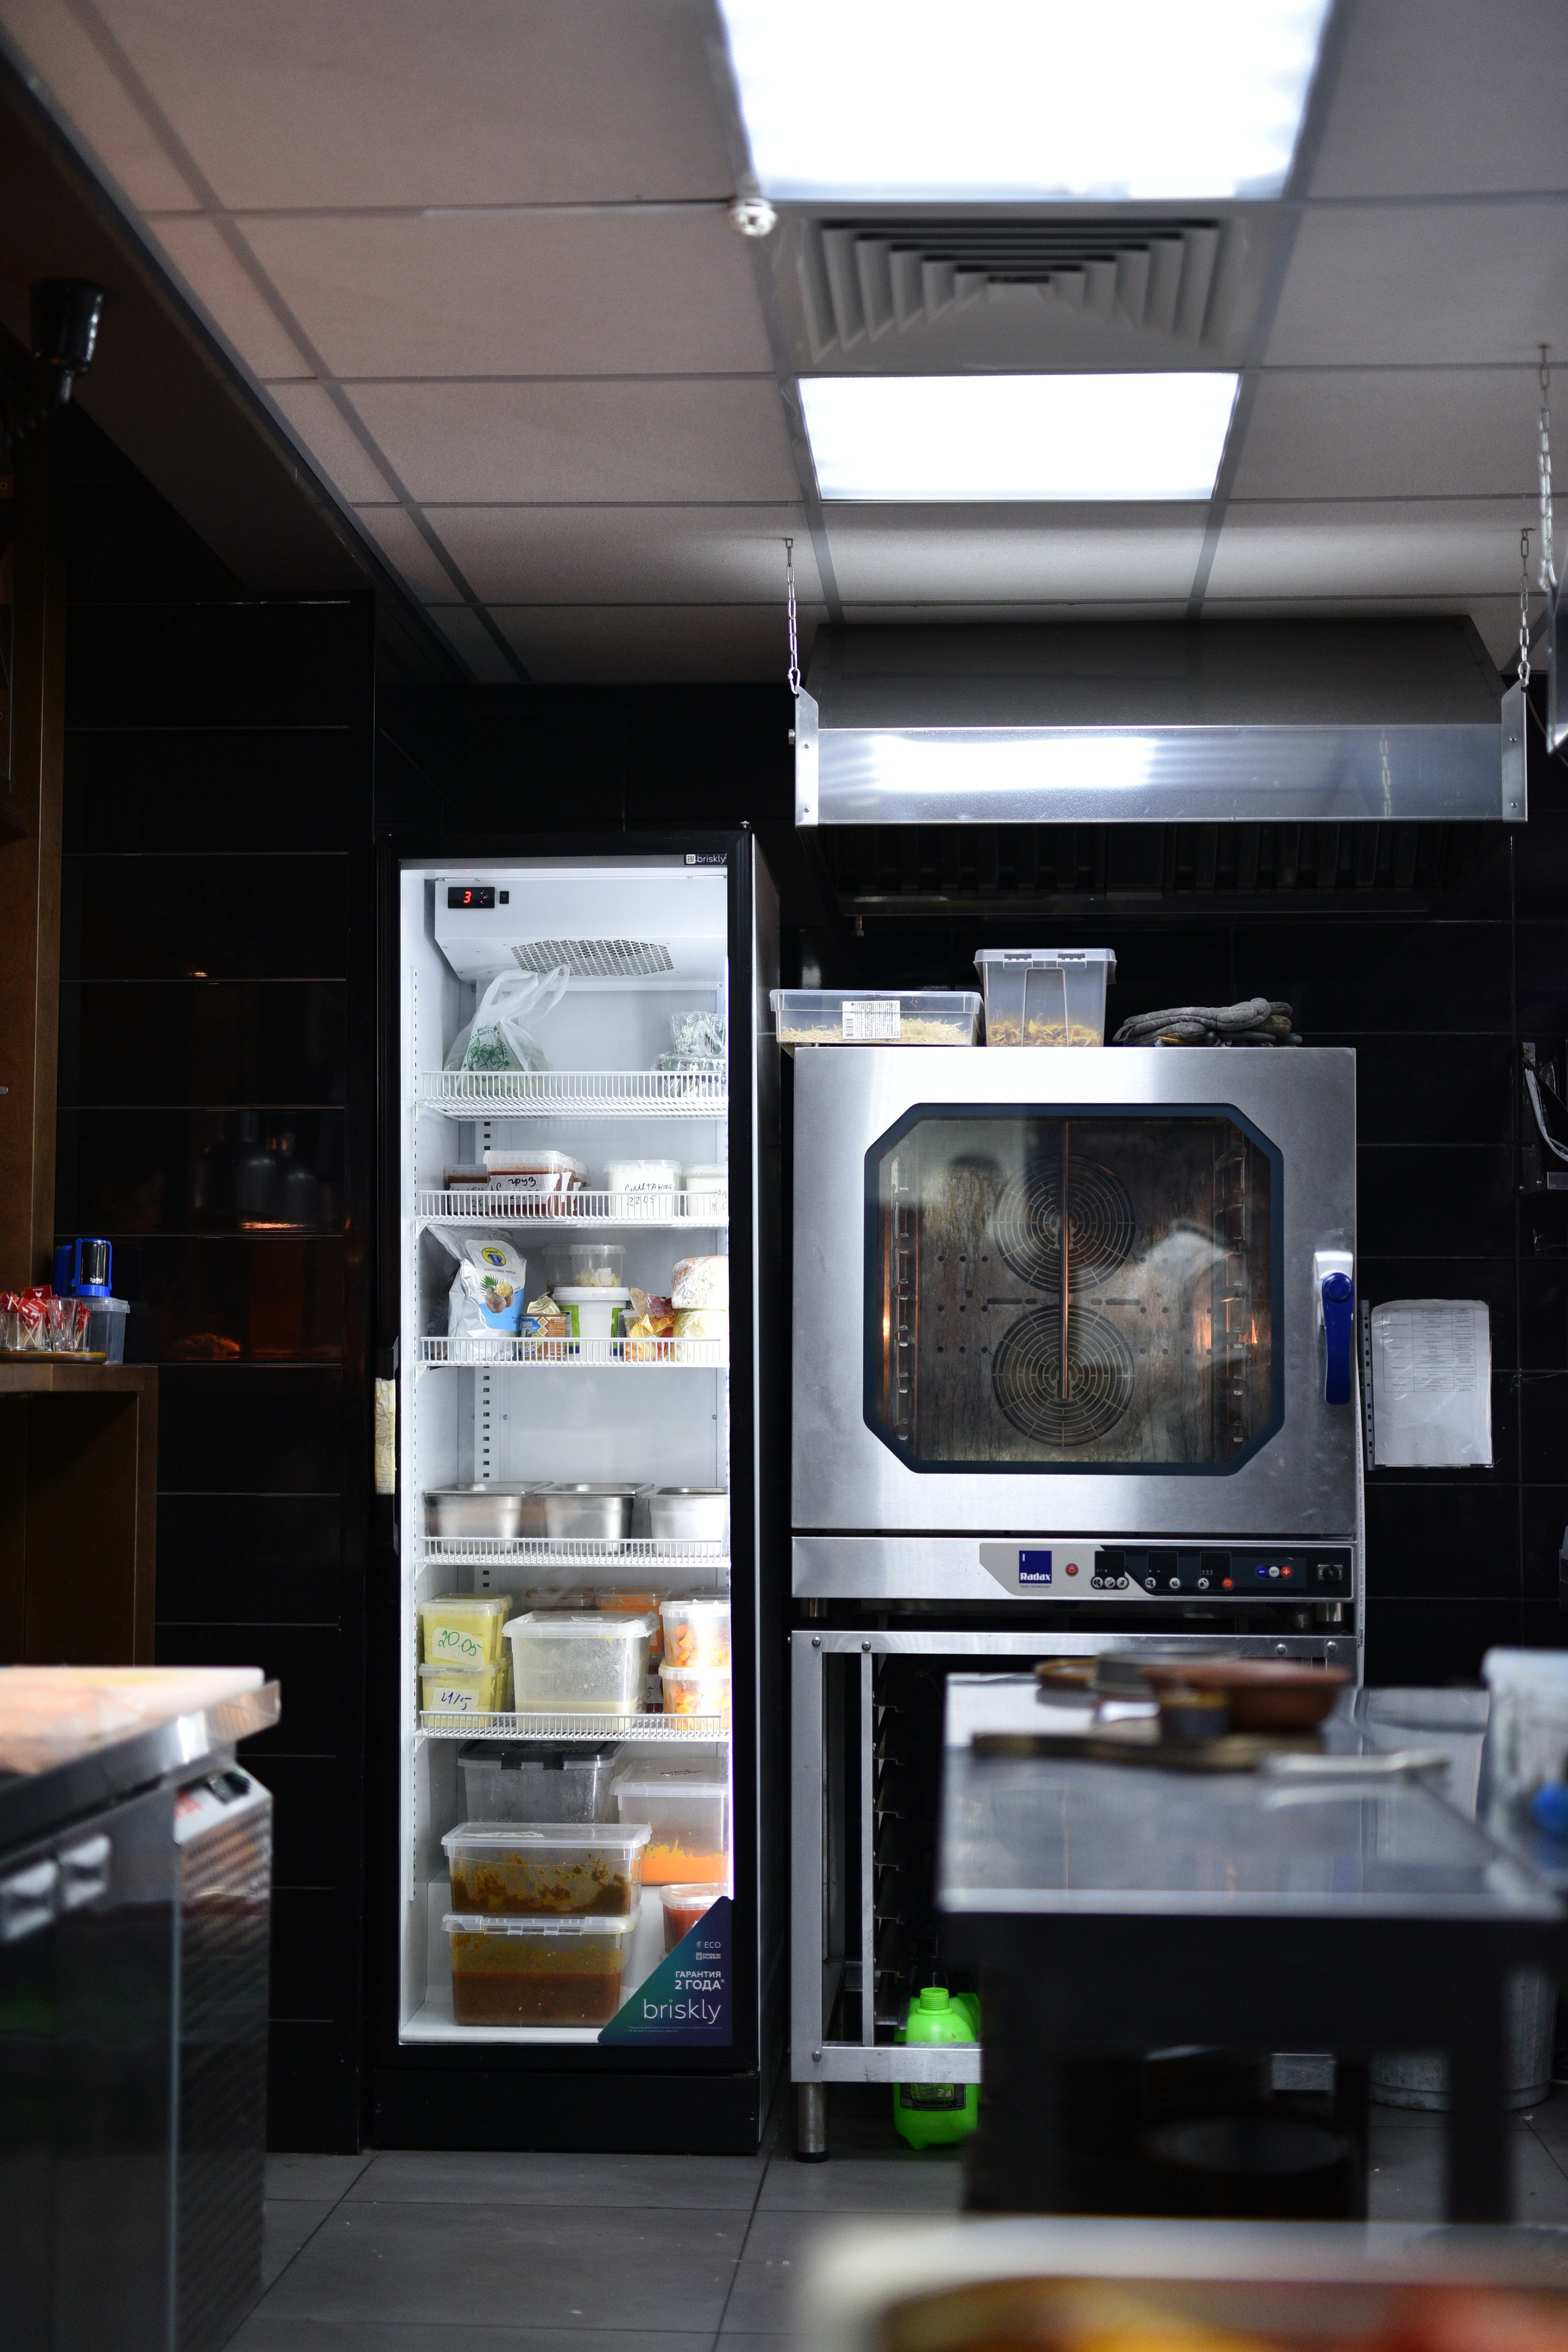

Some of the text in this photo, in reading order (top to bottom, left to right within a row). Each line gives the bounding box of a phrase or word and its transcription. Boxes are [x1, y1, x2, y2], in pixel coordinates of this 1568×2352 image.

[697, 854, 726, 864] briskly
[463, 891, 472, 903] 3
[1020, 1572, 1051, 1581] Radax
[675, 1980, 682, 1990] 2
[644, 1999, 722, 2024] briskly
